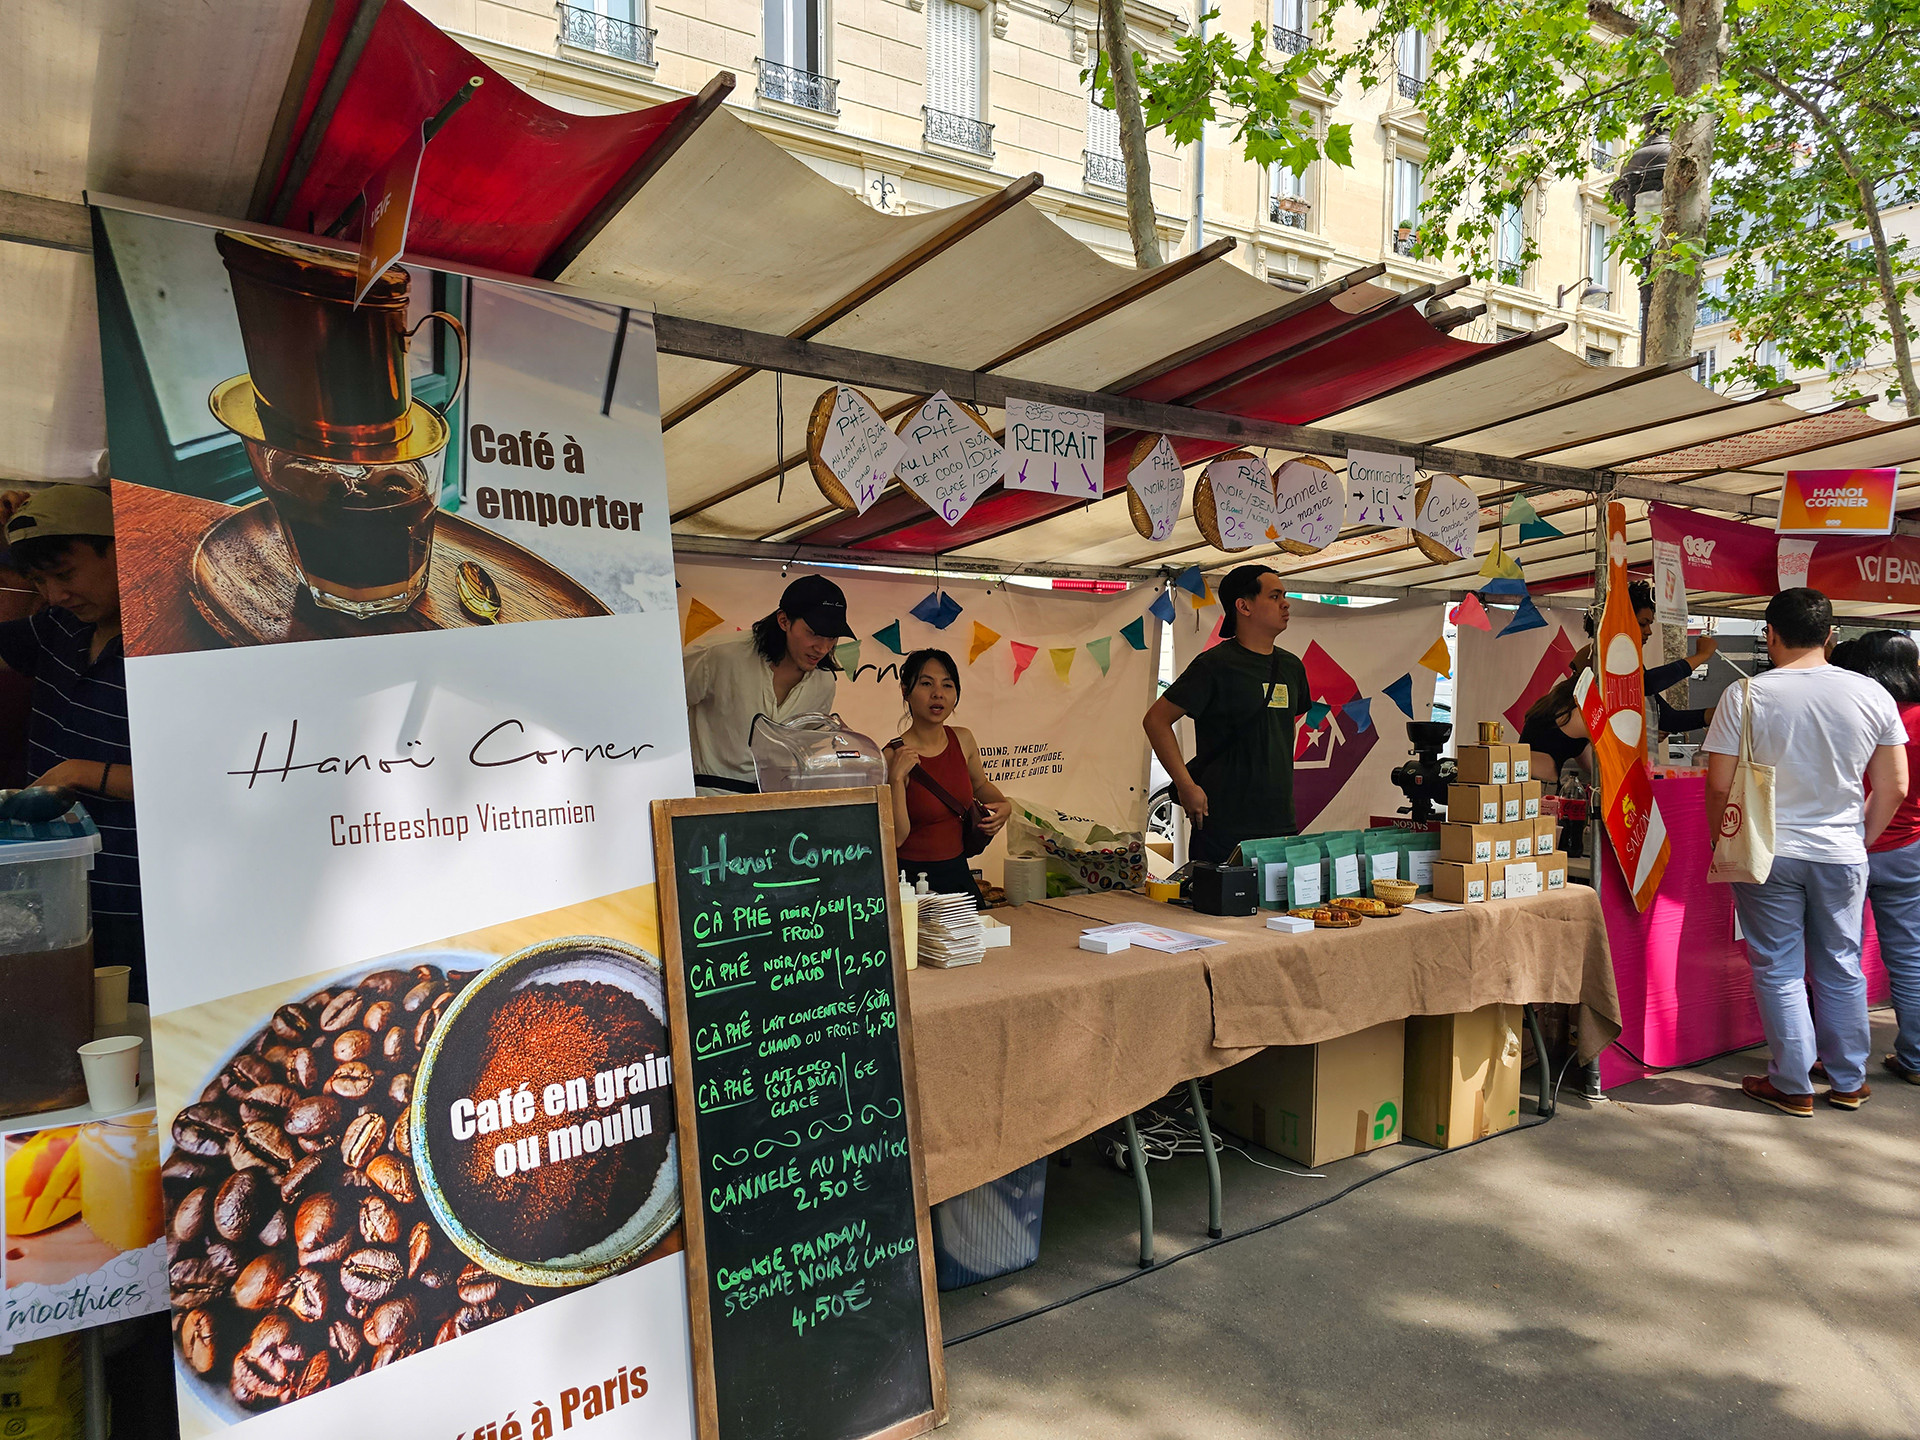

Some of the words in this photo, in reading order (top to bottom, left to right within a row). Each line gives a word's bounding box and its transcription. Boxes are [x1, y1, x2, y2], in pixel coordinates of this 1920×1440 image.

[470, 423, 555, 472] Café
[562, 434, 585, 474] à
[900, 459, 920, 473] AU
[922, 445, 949, 467] LAIT
[1012, 422, 1098, 460] RETRAIT
[913, 473, 929, 487] DE
[935, 461, 964, 481] COCO
[936, 475, 967, 500] GLACÉ
[1276, 471, 1328, 514] Cannelé
[1349, 461, 1412, 496] Commandez
[1812, 487, 1863, 498] HANOI
[476, 485, 643, 532] emporter
[1281, 520, 1293, 531] au
[1297, 496, 1333, 521] manioc
[1804, 498, 1869, 508] CORNER
[1855, 555, 1882, 582] ICI
[227, 719, 435, 789] Hanoï
[469, 719, 654, 767] Corner
[1028, 765, 1049, 776] GUIDE
[1052, 764, 1063, 774] DU
[330, 808, 470, 846] Coffeeshop
[476, 801, 596, 834] Vietnamien
[1393, 820, 1428, 831] SAIGON
[789, 832, 872, 869] Corner
[693, 900, 723, 939] CÀ
[733, 894, 772, 931] PHÊ
[853, 897, 885, 922] 3,50
[782, 922, 825, 942] FROID
[690, 958, 716, 991] CÀ
[720, 952, 752, 981] PHÊ
[843, 949, 887, 976] 2,50
[770, 966, 825, 991] CHAUD
[696, 1023, 722, 1053] CÀ
[725, 1010, 753, 1044] PHÊ
[762, 1015, 786, 1034] LAIT
[758, 1034, 802, 1058] CHAUD
[805, 1030, 822, 1045] OU
[826, 1020, 859, 1038] FROID
[865, 1011, 896, 1038] 4,50
[698, 1078, 720, 1109] CÀ
[723, 1068, 754, 1101] PHÊ
[764, 1066, 797, 1086] LAIT
[797, 1060, 832, 1076] COCO
[771, 1090, 820, 1118] GLACÉ
[450, 1081, 535, 1141] Café
[543, 1076, 588, 1116] en
[494, 1135, 541, 1178] ou
[548, 1103, 652, 1163] moulu
[709, 1156, 802, 1213] CANNELÉ
[809, 1155, 834, 1180] AU
[842, 1131, 908, 1173] MANIOC
[724, 1270, 794, 1318] SÉSAME
[798, 1254, 844, 1291] NOIR
[844, 1245, 860, 1272] &
[863, 1236, 916, 1269] CHOCO
[5, 1284, 145, 1331] moothies
[792, 1278, 873, 1338] 4,50€
[560, 1365, 649, 1431] Paris
